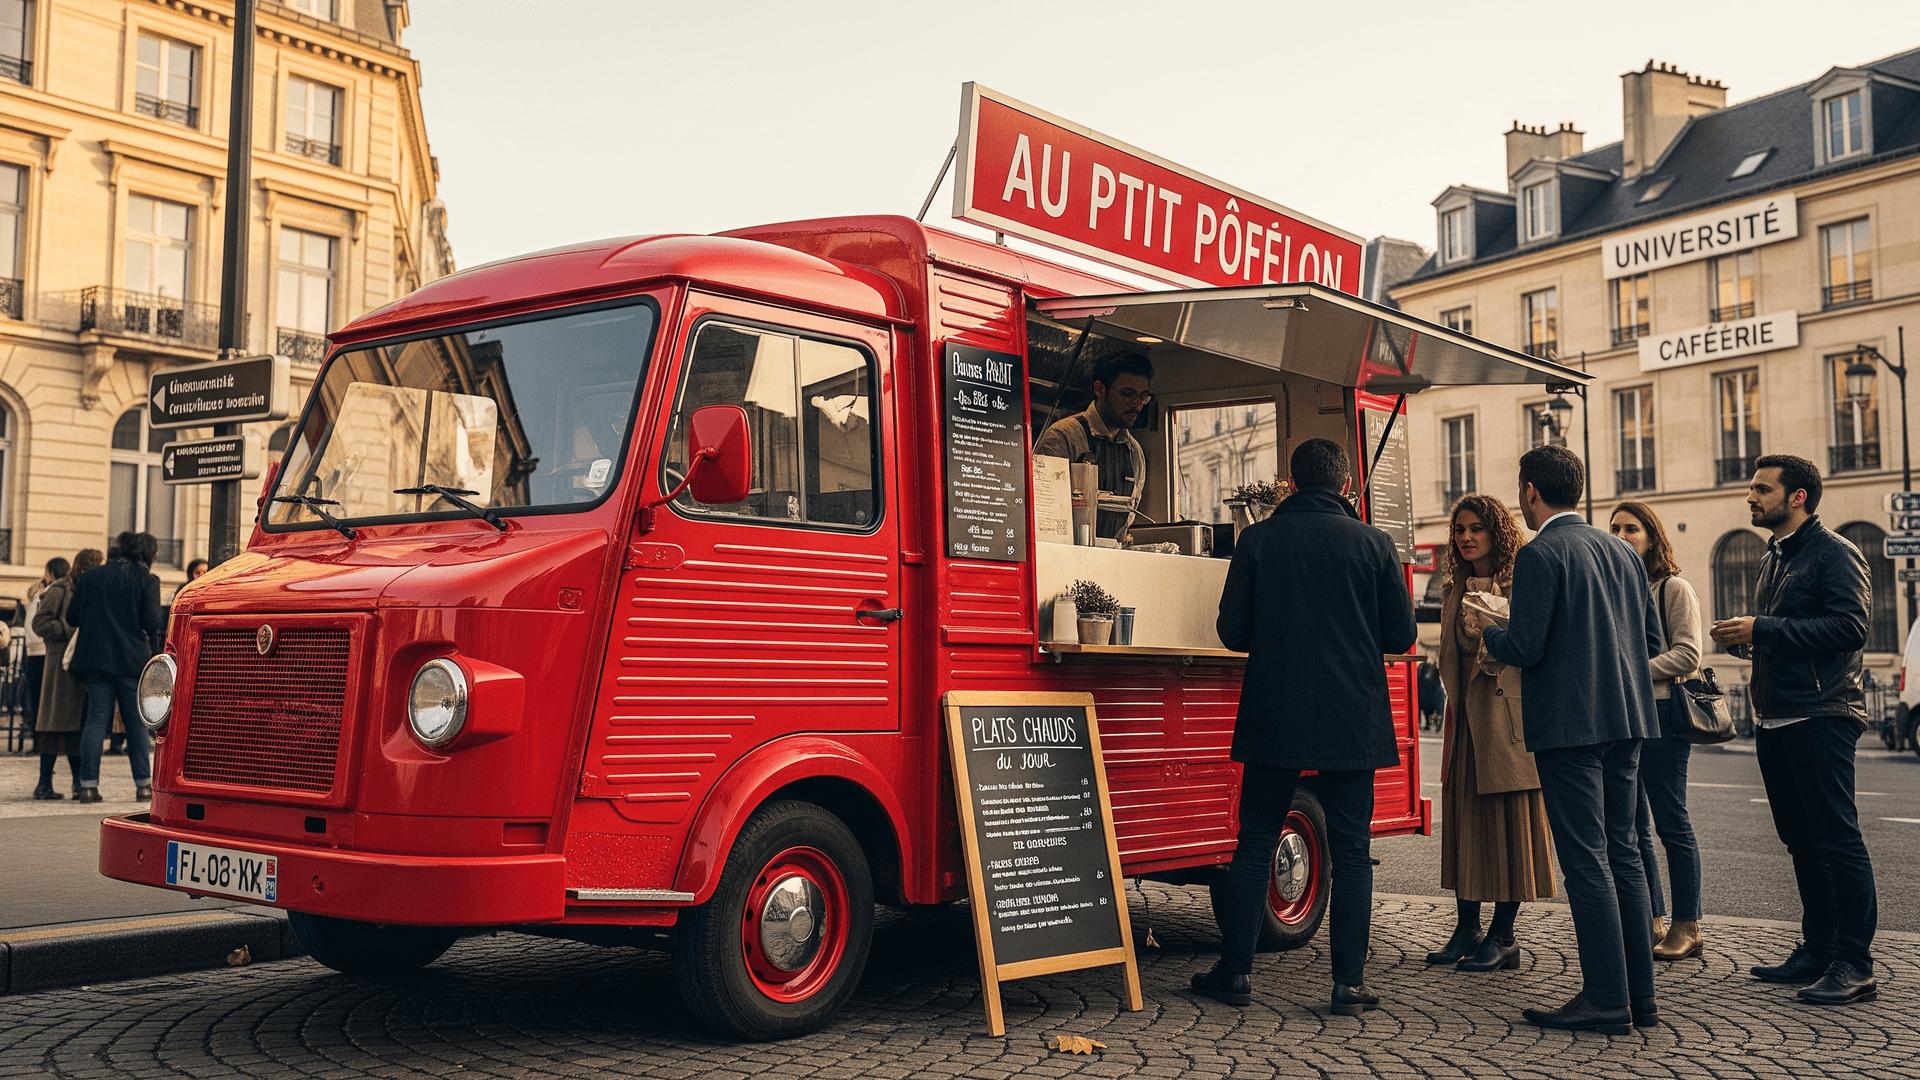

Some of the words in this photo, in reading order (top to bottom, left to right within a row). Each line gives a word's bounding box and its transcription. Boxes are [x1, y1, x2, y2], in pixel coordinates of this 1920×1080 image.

[1002, 133, 1071, 218] AU
[1090, 162, 1182, 254] PTIT
[1615, 202, 1780, 269] UNIVERSITÉ
[972, 716, 1017, 745] PLATS
[1022, 716, 1077, 744] CHAUDS
[1019, 751, 1057, 770] JOUR
